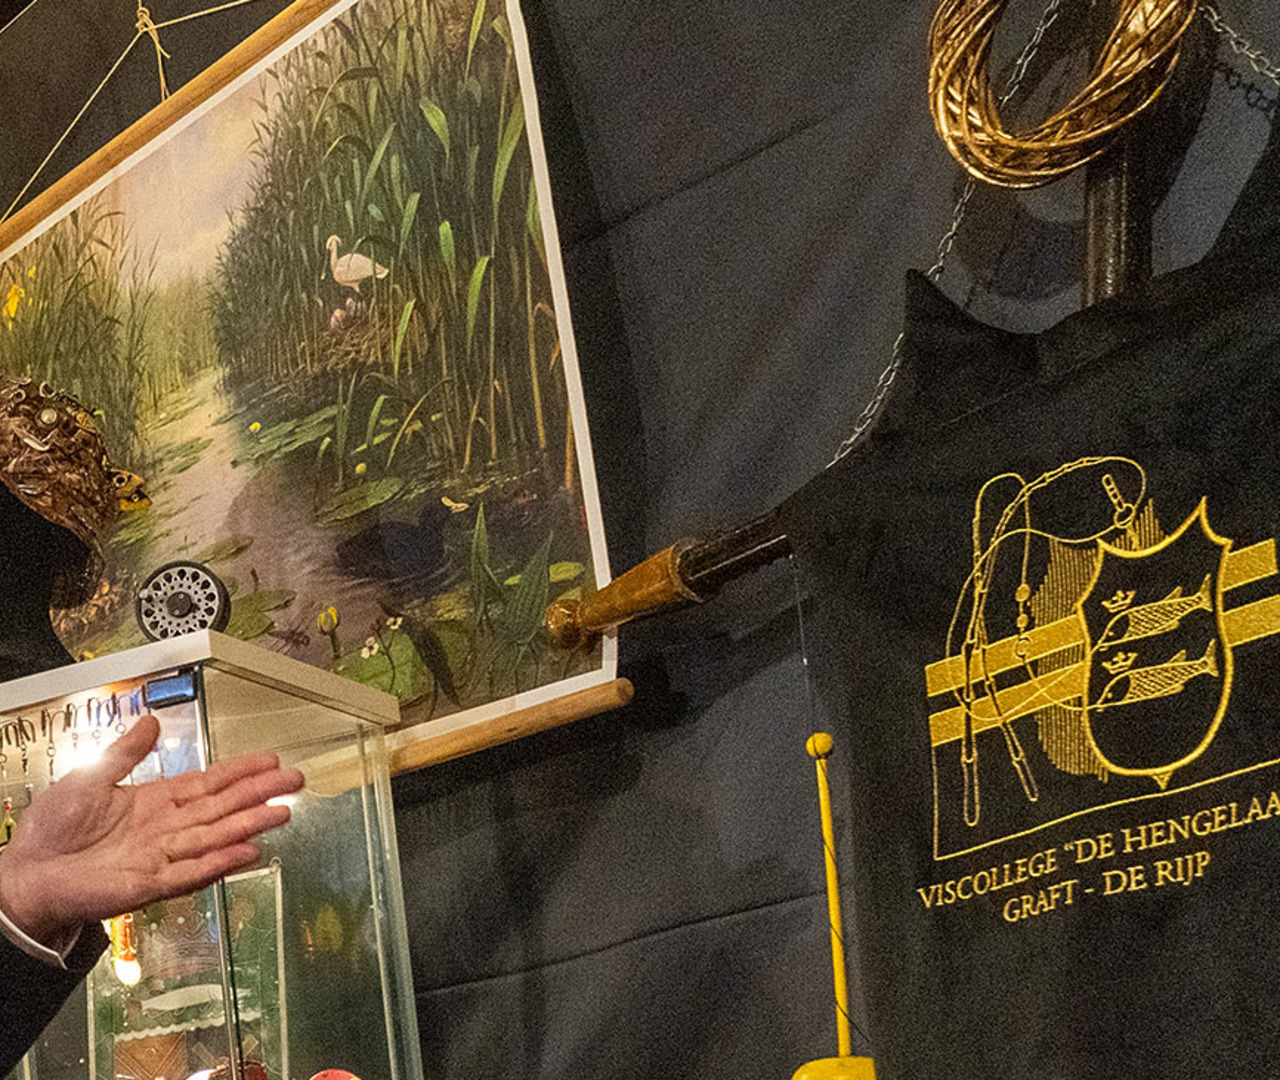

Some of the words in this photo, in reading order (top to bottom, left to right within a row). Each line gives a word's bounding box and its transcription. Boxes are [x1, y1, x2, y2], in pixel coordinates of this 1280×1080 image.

[916, 848, 1058, 909] VISCOLLEGE
[1002, 878, 1080, 923] GRAFT
[1101, 865, 1148, 896] DE
[1153, 850, 1211, 886] RIJP
